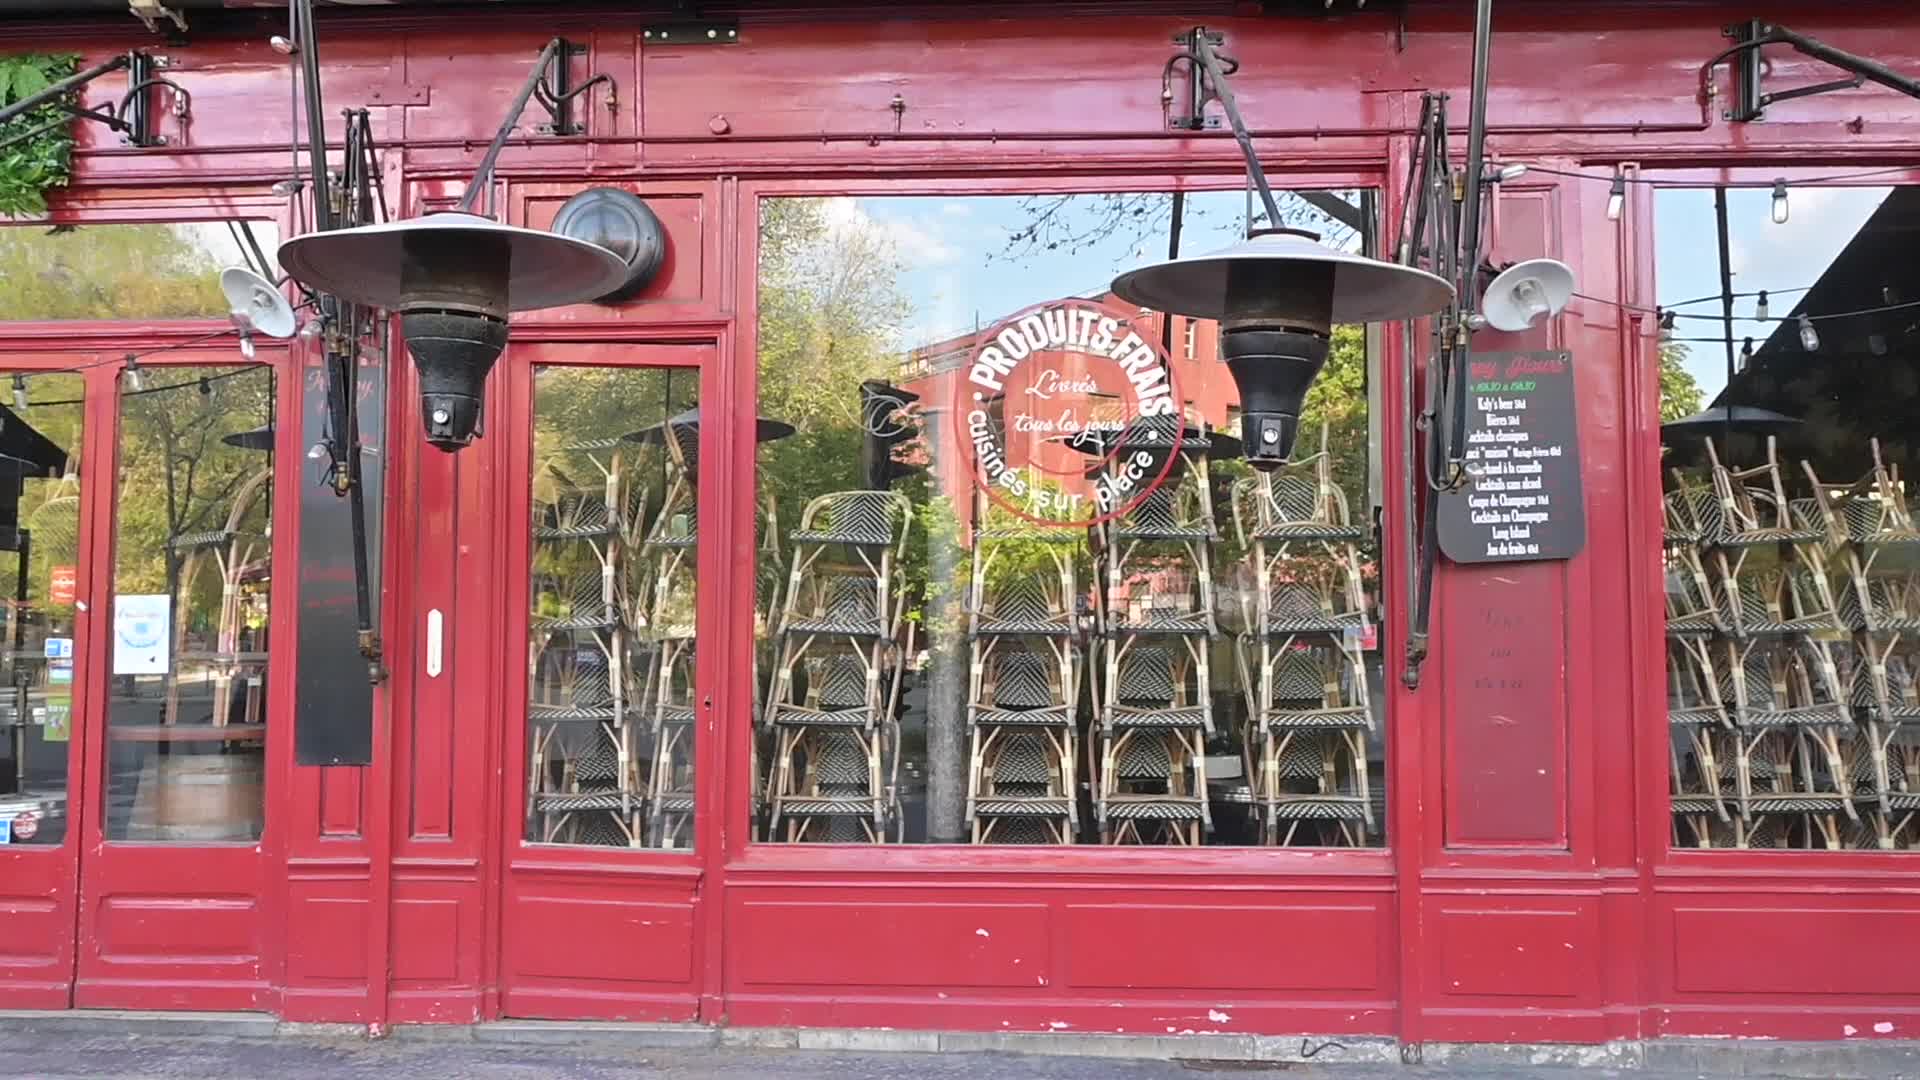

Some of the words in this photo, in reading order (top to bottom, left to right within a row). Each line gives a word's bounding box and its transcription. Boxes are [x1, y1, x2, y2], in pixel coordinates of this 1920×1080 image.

[969, 308, 1118, 392] PRODUITS
[1110, 332, 1174, 417] FRAIS
[1025, 369, 1097, 399] Livrés
[1486, 413, 1507, 426] Bières
[1014, 412, 1054, 433] tous
[1057, 409, 1079, 433] les
[1073, 417, 1126, 447] jours
[1468, 429, 1495, 443] ocktails
[1496, 429, 1529, 444] classiques
[1037, 488, 1083, 510] sur
[1096, 450, 1154, 512] place
[1522, 476, 1542, 489] alcool
[1468, 494, 1489, 509] Coupe
[1490, 494, 1498, 507] de
[1499, 493, 1536, 508] Champagne
[1471, 510, 1501, 524] Cocktails
[1511, 509, 1549, 524] Champagne
[1492, 525, 1509, 541] Long
[1509, 524, 1530, 538] Island
[1486, 542, 1499, 556] Jus
[1499, 541, 1507, 555] de
[1508, 542, 1526, 555] fruits
